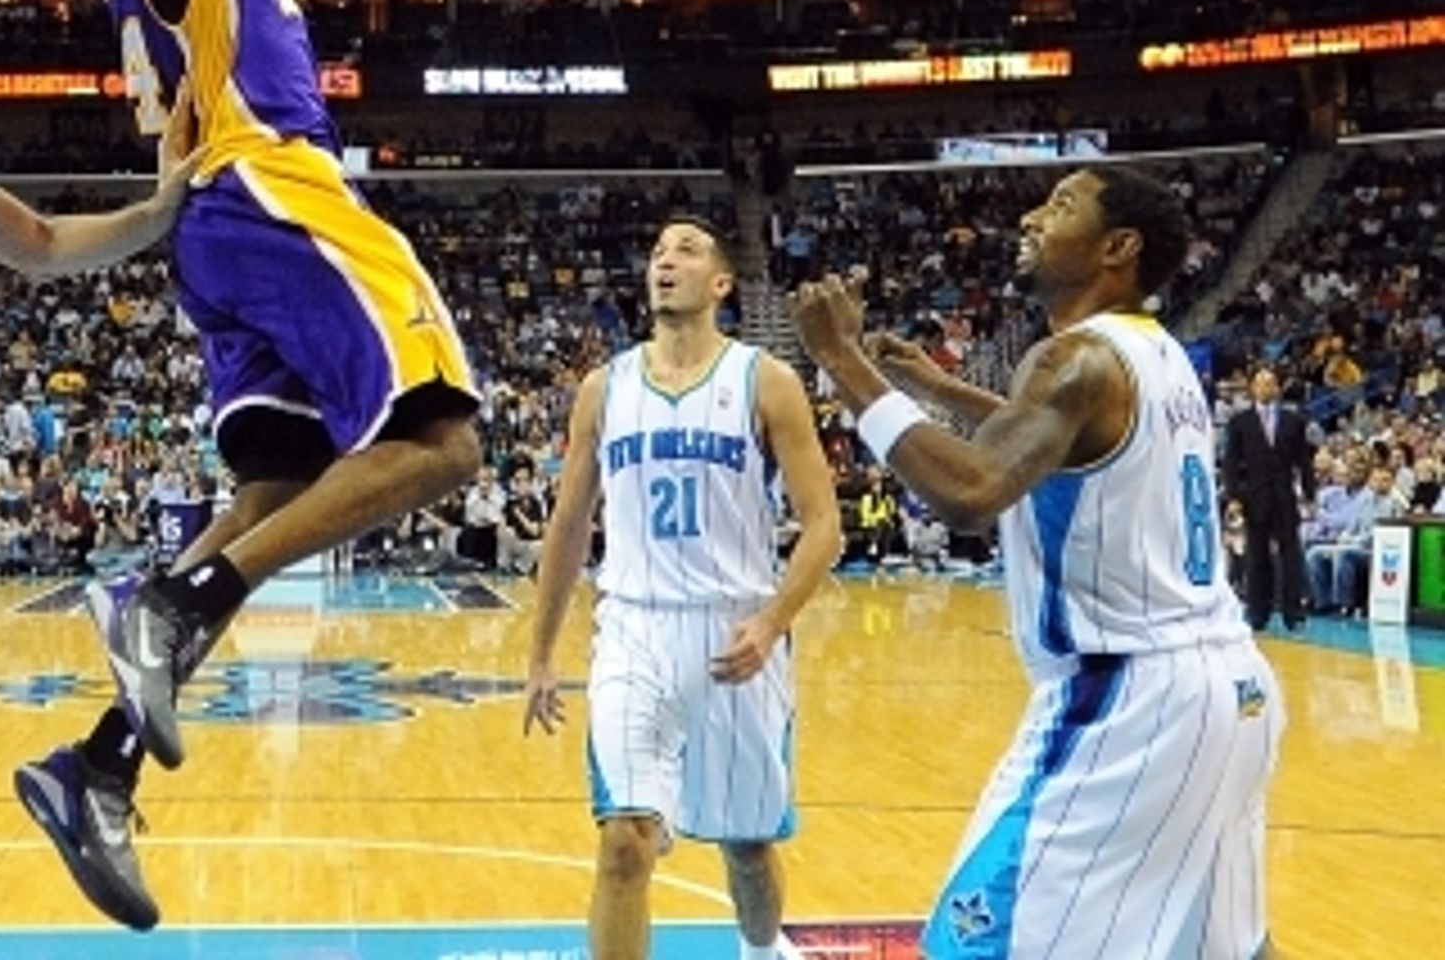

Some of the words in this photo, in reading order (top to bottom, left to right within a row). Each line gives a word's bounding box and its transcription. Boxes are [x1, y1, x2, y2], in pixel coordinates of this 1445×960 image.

[651, 427, 747, 473] ORLEANS
[650, 476, 701, 540] 21
[1182, 452, 1215, 586] 8
